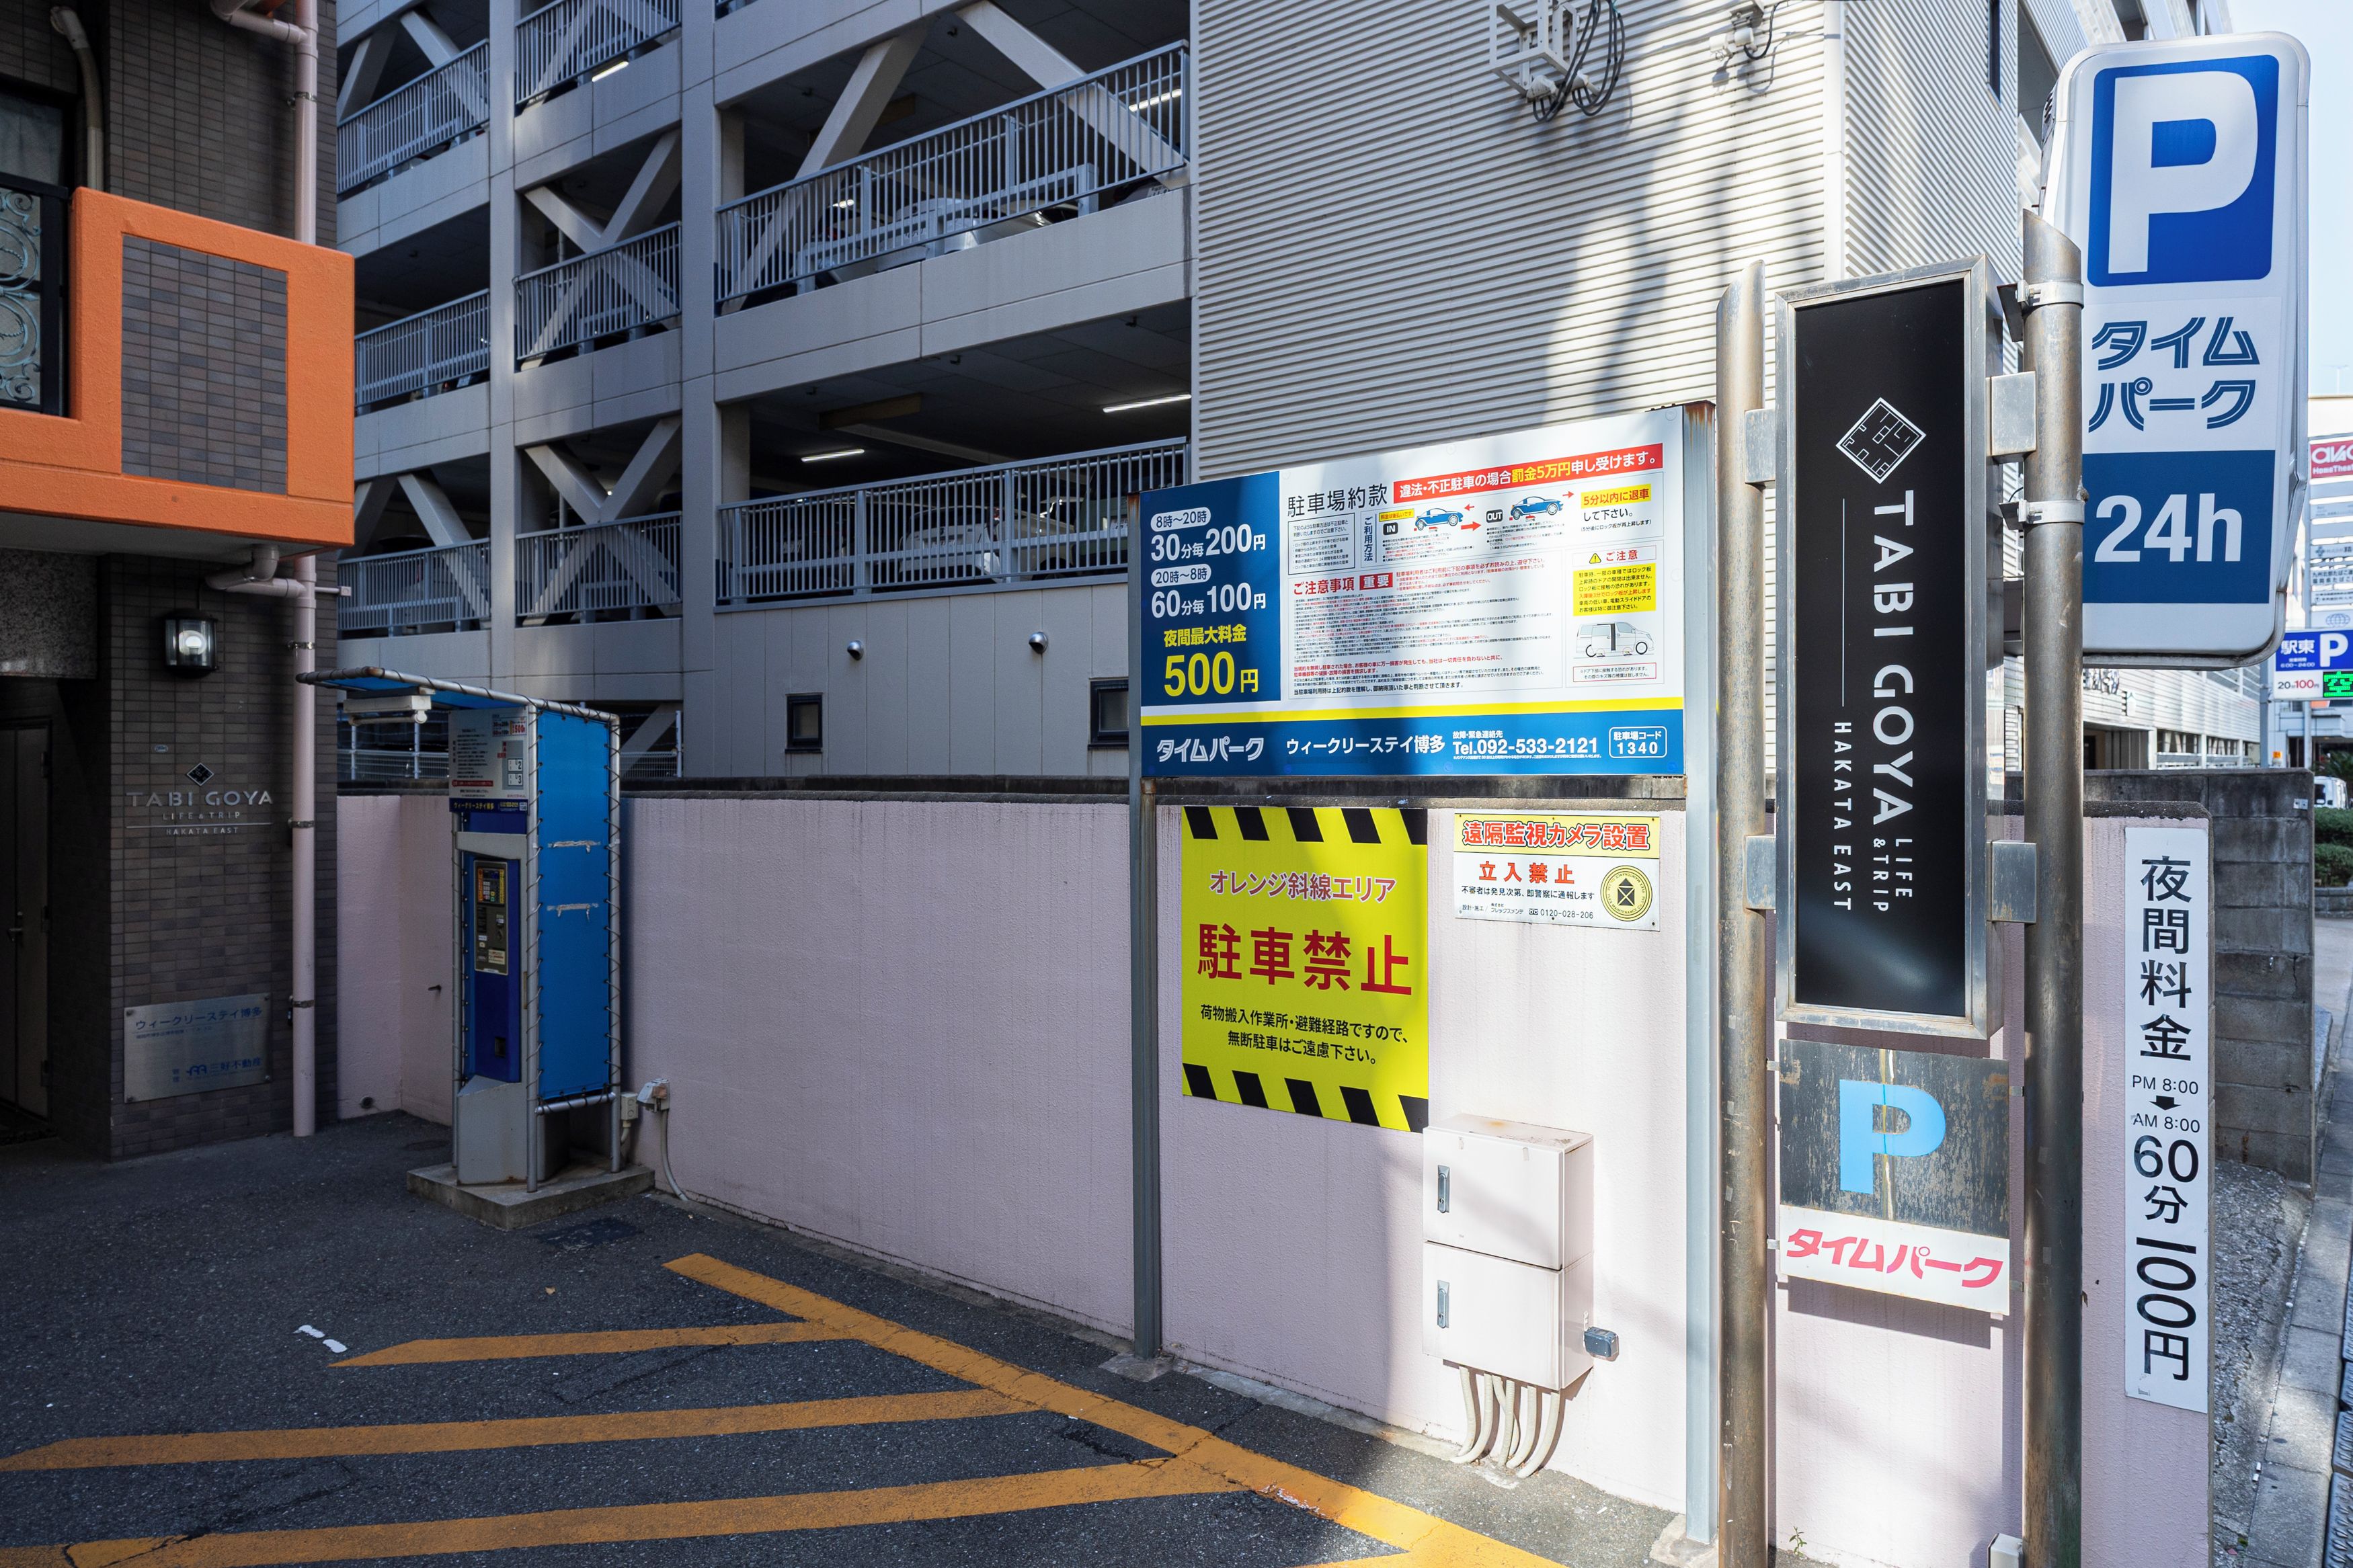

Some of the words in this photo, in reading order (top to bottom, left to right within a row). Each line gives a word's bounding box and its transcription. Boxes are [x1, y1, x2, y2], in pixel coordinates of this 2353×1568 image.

[2108, 71, 2258, 274] P
[2092, 317, 2260, 371] タイム
[2089, 377, 2256, 433] パーク
[1287, 483, 1387, 518] 駐車場約款
[1584, 489, 1649, 505] 5分以内に退車
[1386, 525, 1396, 533] IN
[1487, 512, 1503, 520] OUT
[1584, 507, 1632, 521] して下さい。
[2094, 493, 2242, 562] 24h
[1364, 516, 1373, 561] ご利用方法
[1606, 550, 1638, 561] ご注意
[1874, 490, 1914, 636] TABI
[1294, 577, 1354, 595] ご注意事項
[1363, 575, 1389, 588] 重要
[1164, 623, 1246, 647] 夜間最大料金
[2280, 639, 2315, 655] 駅東
[2320, 632, 2348, 667] P
[1164, 651, 1258, 697] 500円
[2323, 671, 2353, 698] 空
[1157, 735, 1264, 763] タイムパーク
[1286, 734, 1445, 756] ウィークリーステイ博多
[1452, 737, 1597, 755] Tel.092-533-2121
[1613, 731, 1662, 741] 駐車場コード
[1873, 664, 1914, 825] GOYA
[1834, 722, 1851, 829] HAKATA
[126, 792, 193, 807] TABI
[206, 790, 273, 806] GOYA
[1463, 820, 1650, 850] 遠隔監視カメラ設置
[1479, 861, 1574, 884] 立入禁止
[1834, 845, 1851, 911] EAST
[1895, 838, 1913, 897] LIFE
[1210, 869, 1396, 903] オレンジ斜線エリア
[1462, 886, 1595, 901] 不審者は発見次第、即警察に通報します
[1541, 909, 1594, 919] 0120-028-206
[1198, 923, 1412, 995] 駐車禁止
[2140, 856, 2192, 1061] 夜間料金
[135, 1006, 263, 1030] ウィークリーステイ博多
[1201, 1003, 1408, 1043] 荷物搬入作業所・避難経路ですので、
[1228, 1030, 1375, 1065] 無断駐車はご遠慮下さい。
[2132, 1075, 2156, 1090] PM
[2163, 1078, 2198, 1095] 8:00
[1839, 1079, 1946, 1194] P
[2132, 1112, 2157, 1128] AM
[2164, 1116, 2200, 1133] 8:00
[1787, 1229, 2003, 1288] タイムパーク
